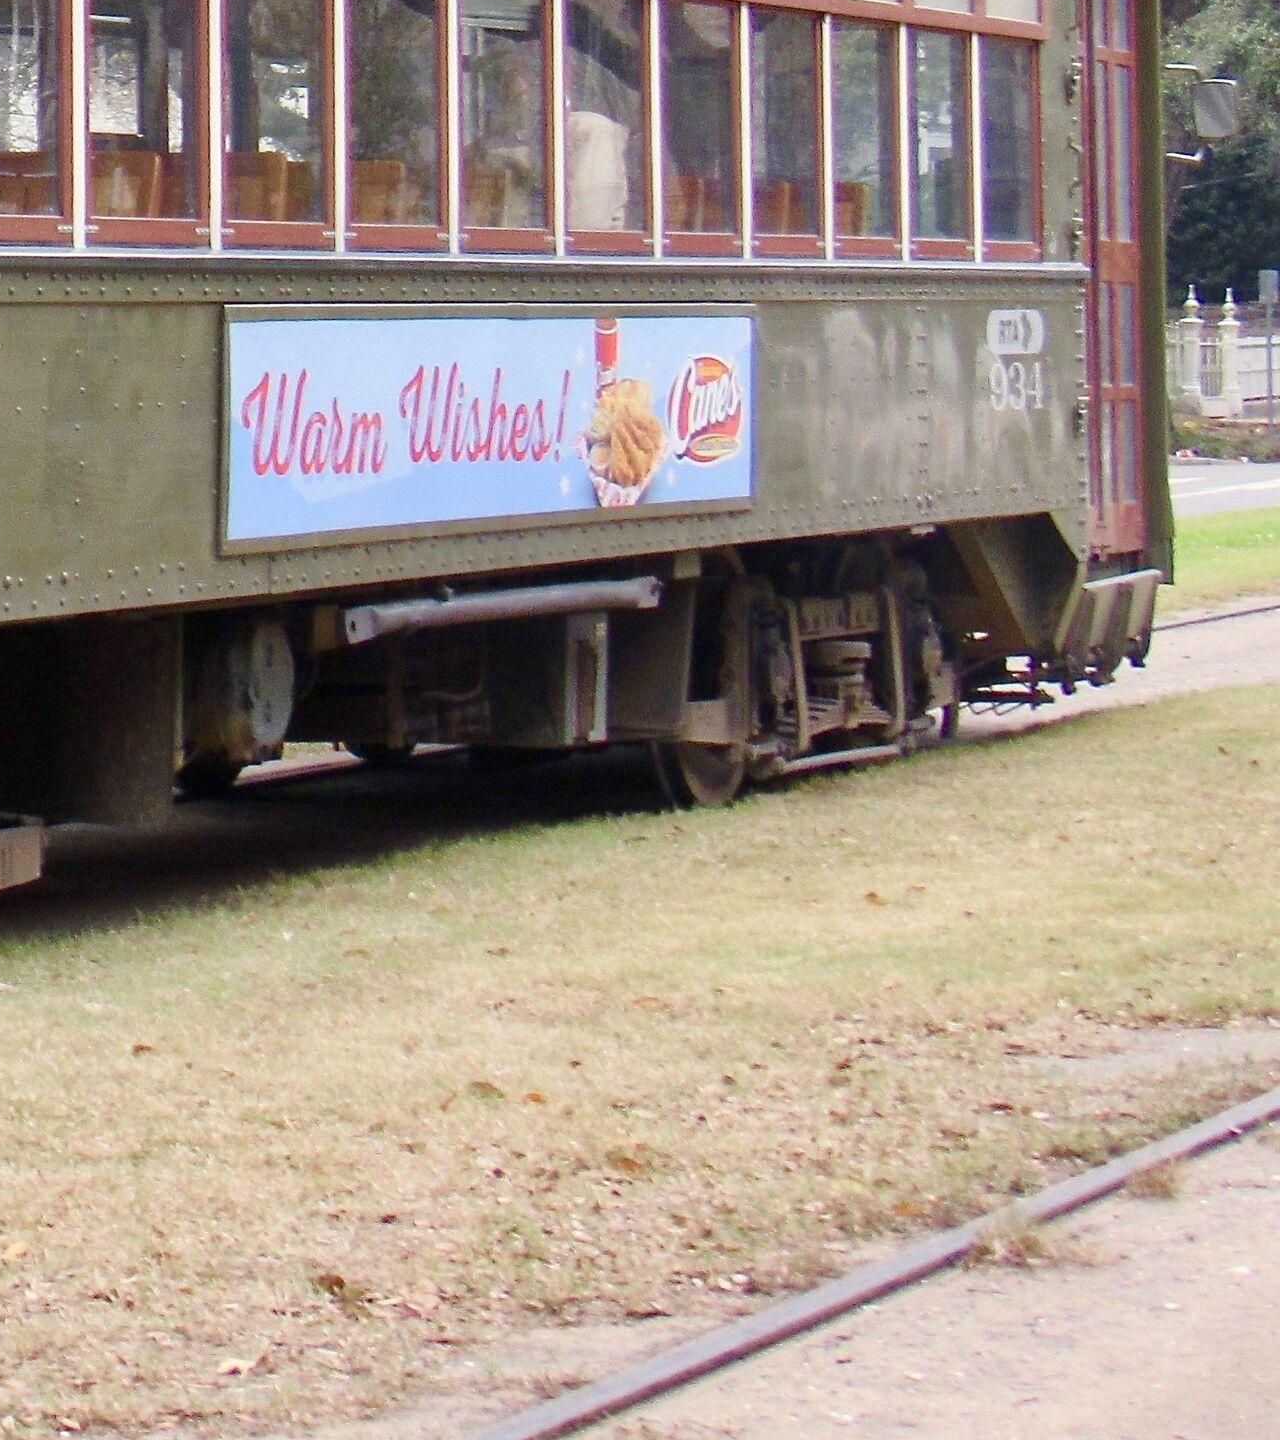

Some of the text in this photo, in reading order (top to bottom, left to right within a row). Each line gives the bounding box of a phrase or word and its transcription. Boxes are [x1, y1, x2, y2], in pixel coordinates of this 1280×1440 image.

[241, 361, 571, 476] Warm Wishes!
[990, 361, 1043, 412] 934
